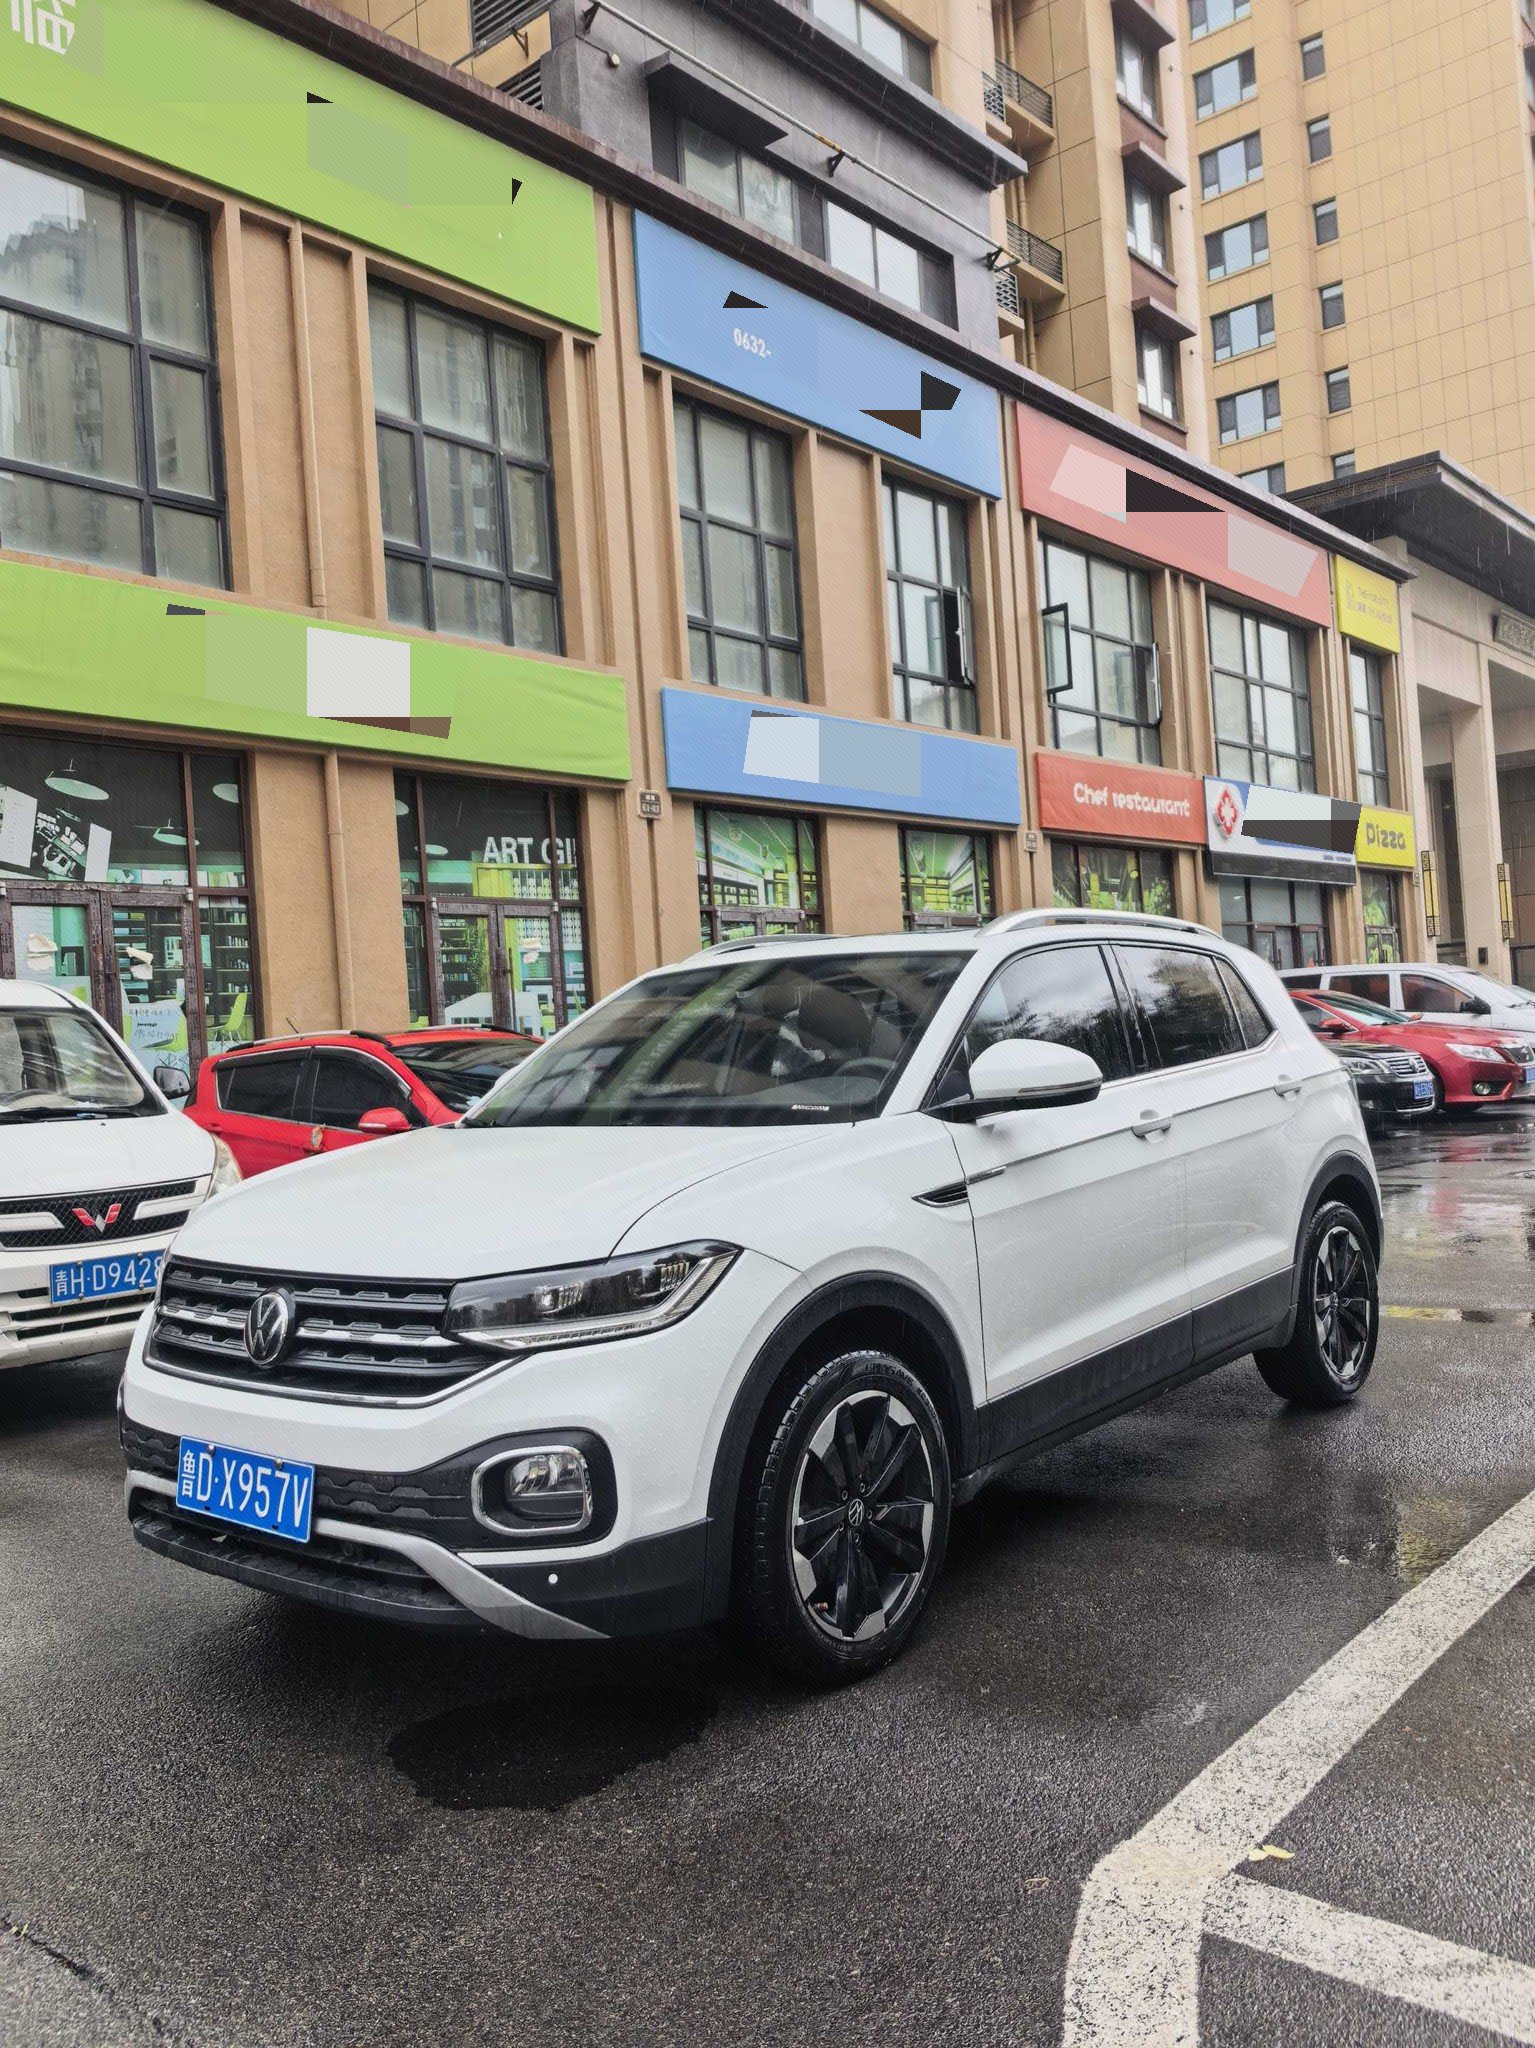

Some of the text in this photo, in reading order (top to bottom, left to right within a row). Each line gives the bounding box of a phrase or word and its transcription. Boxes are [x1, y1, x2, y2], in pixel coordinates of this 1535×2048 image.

[1073, 782, 1190, 817] Chef restaurant
[483, 836, 534, 864] ART
